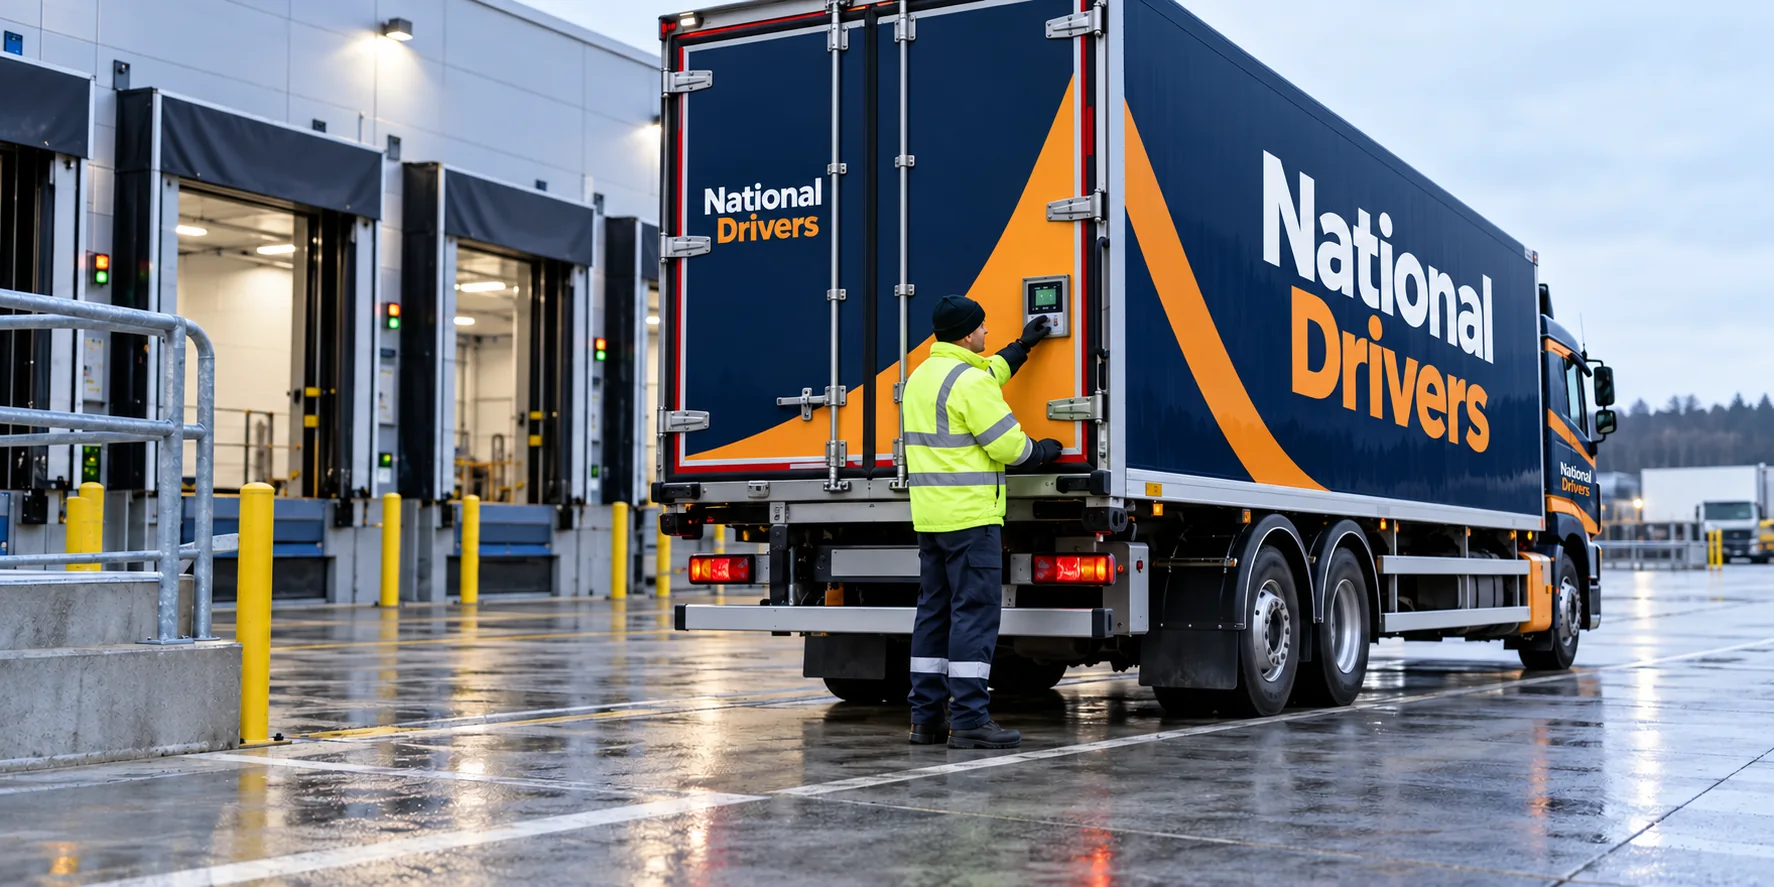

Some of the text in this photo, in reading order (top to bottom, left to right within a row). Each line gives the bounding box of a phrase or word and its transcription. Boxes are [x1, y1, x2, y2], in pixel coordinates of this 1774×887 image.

[705, 178, 822, 215] National
[717, 213, 819, 244] Drivers
[1262, 150, 1494, 365] National
[1290, 285, 1490, 453] Drivers
[1560, 461, 1592, 484] National
[1561, 477, 1591, 497] Drivers
